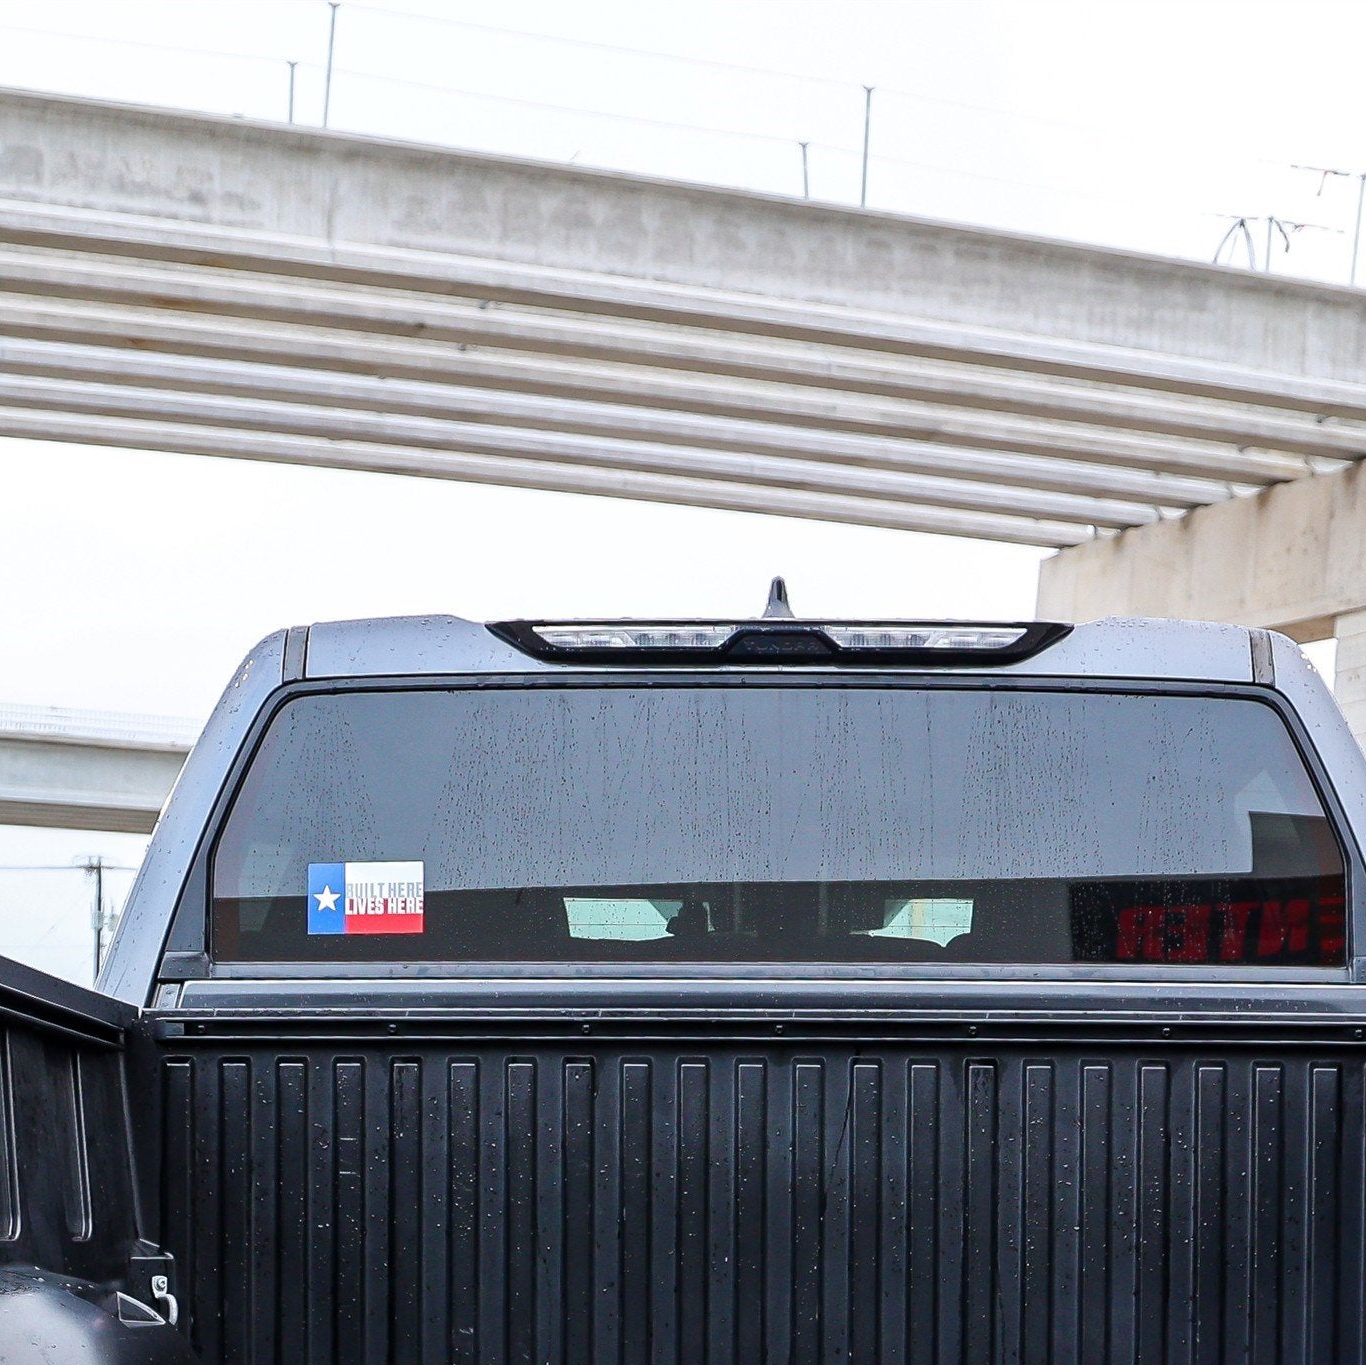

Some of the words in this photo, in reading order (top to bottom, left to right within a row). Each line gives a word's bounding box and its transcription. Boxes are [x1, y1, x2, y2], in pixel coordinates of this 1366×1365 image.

[346, 882, 385, 898] BUILT
[388, 881, 423, 898] HERE
[345, 897, 385, 914] LIVES
[388, 897, 424, 914] HERE
